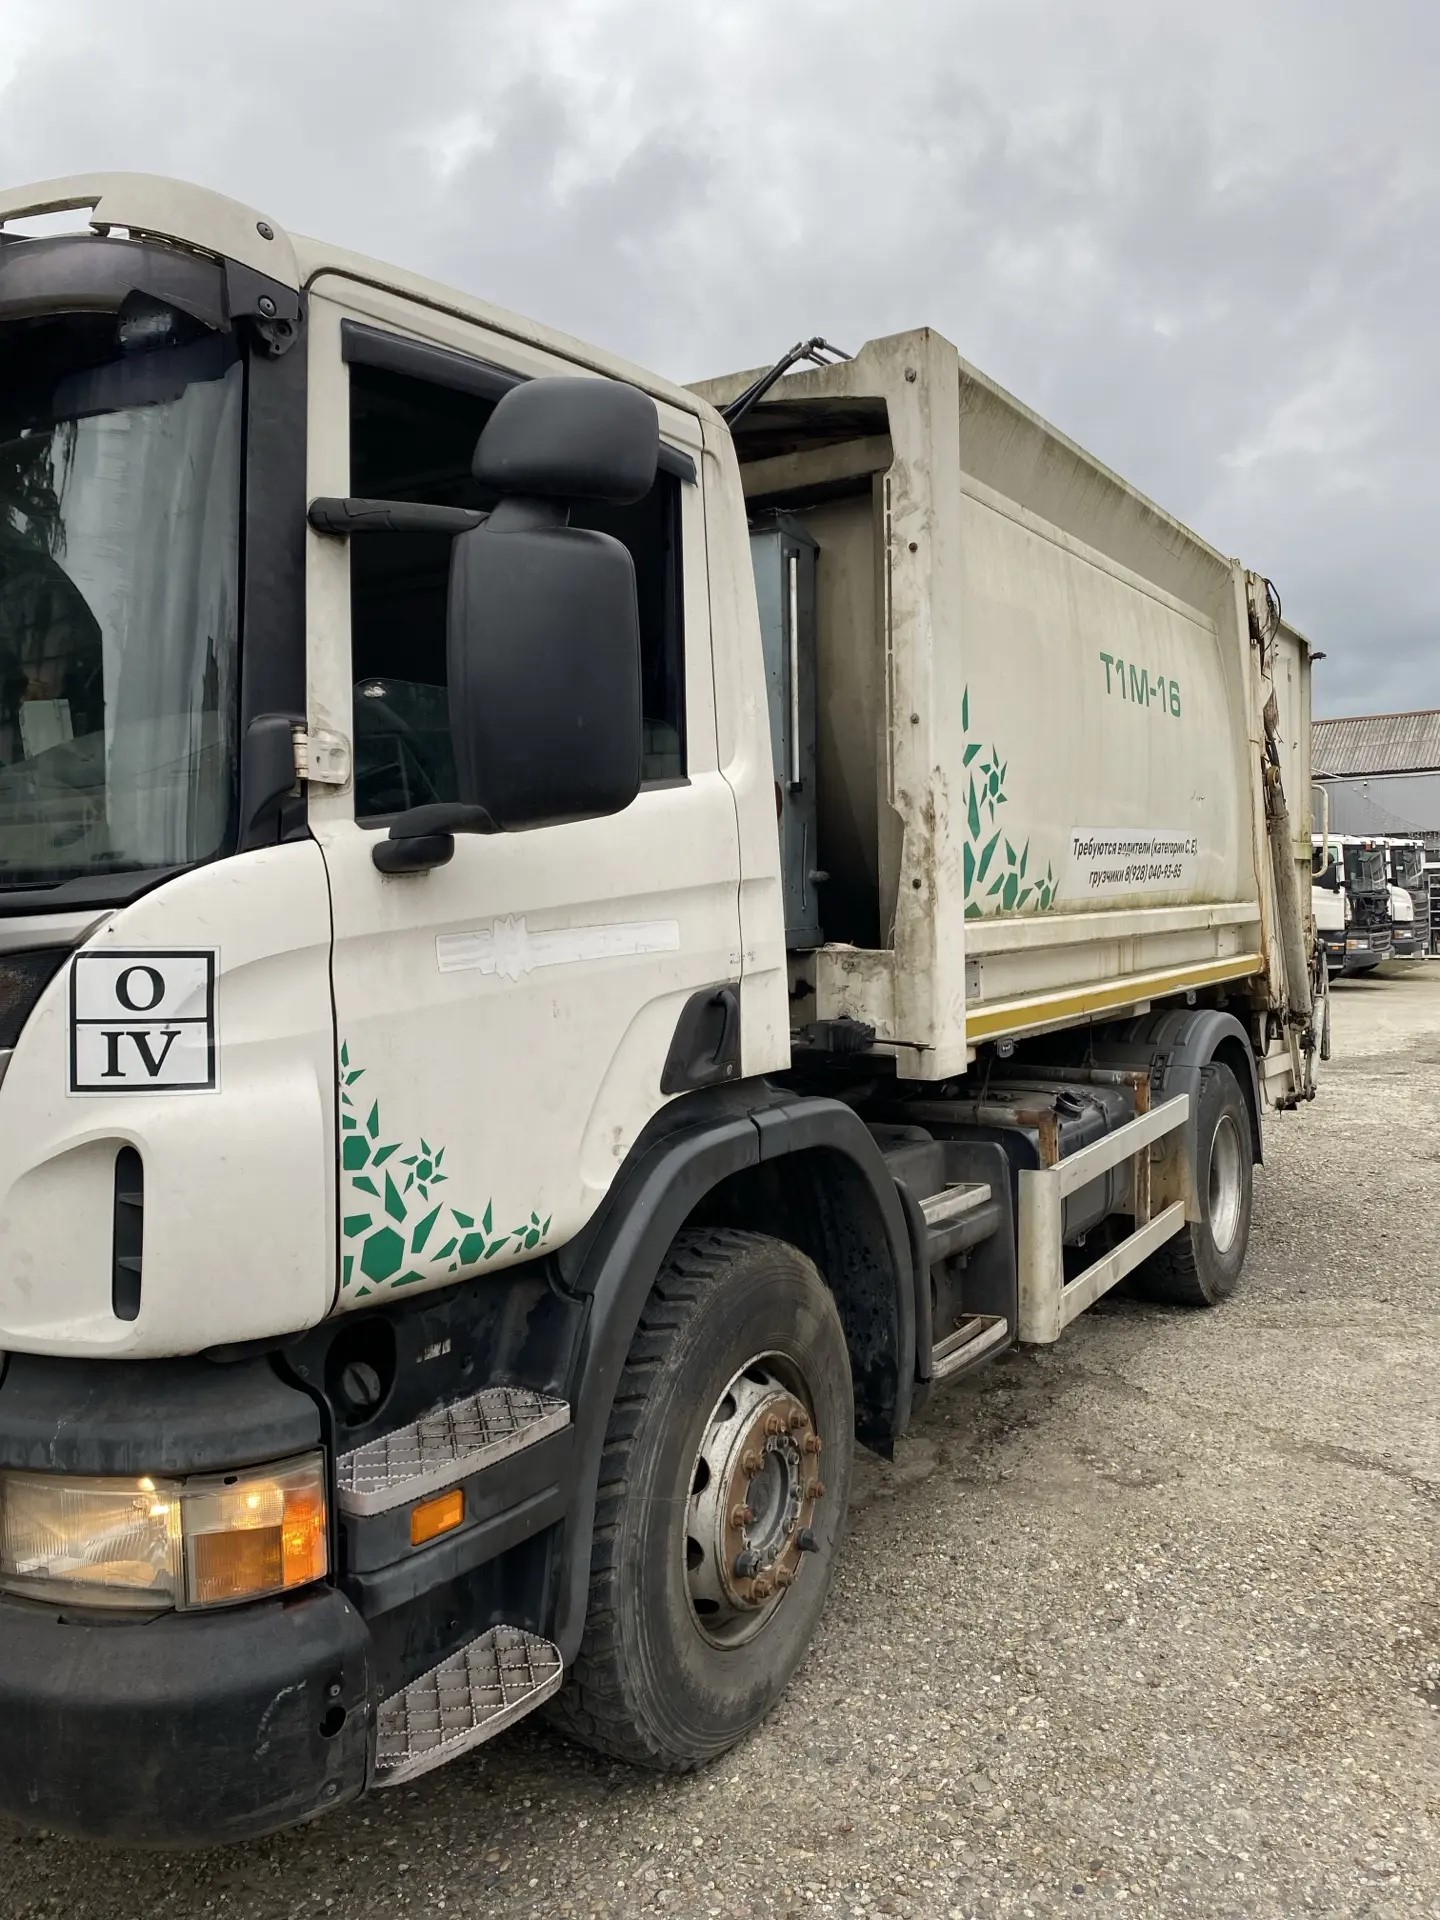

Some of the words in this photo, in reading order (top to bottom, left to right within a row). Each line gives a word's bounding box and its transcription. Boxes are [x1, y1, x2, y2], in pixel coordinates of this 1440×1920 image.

[1073, 837, 1117, 860] Требуются
[1118, 841, 1151, 857] водители
[1151, 837, 1185, 858] (категории
[1089, 869, 1125, 888] грузчики
[1125, 864, 1149, 884] 8(928)
[100, 1030, 182, 1077] IV
